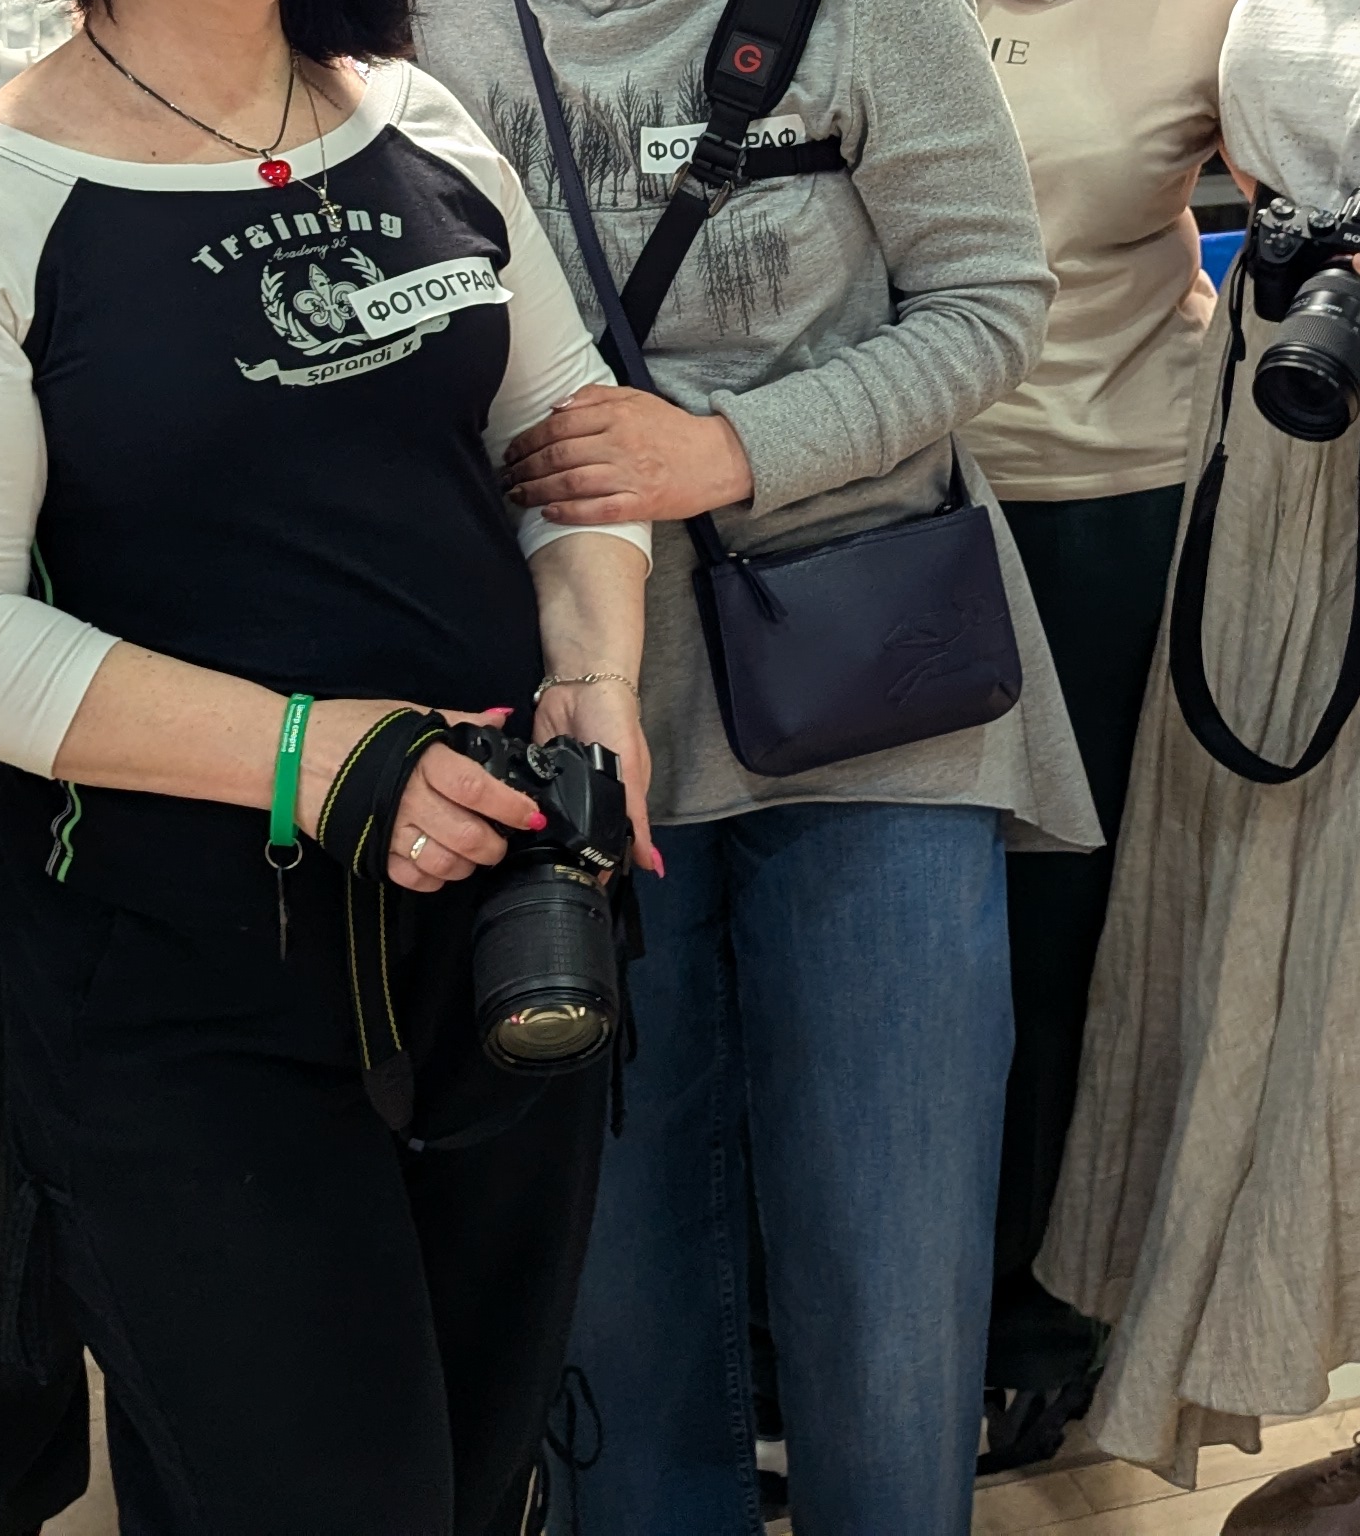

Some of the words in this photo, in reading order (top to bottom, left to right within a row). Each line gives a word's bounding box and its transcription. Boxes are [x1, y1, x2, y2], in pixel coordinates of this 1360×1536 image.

[366, 267, 496, 323] ФОТОГРАФ
[306, 345, 394, 384] sprandi
[579, 846, 615, 868] Nikon
